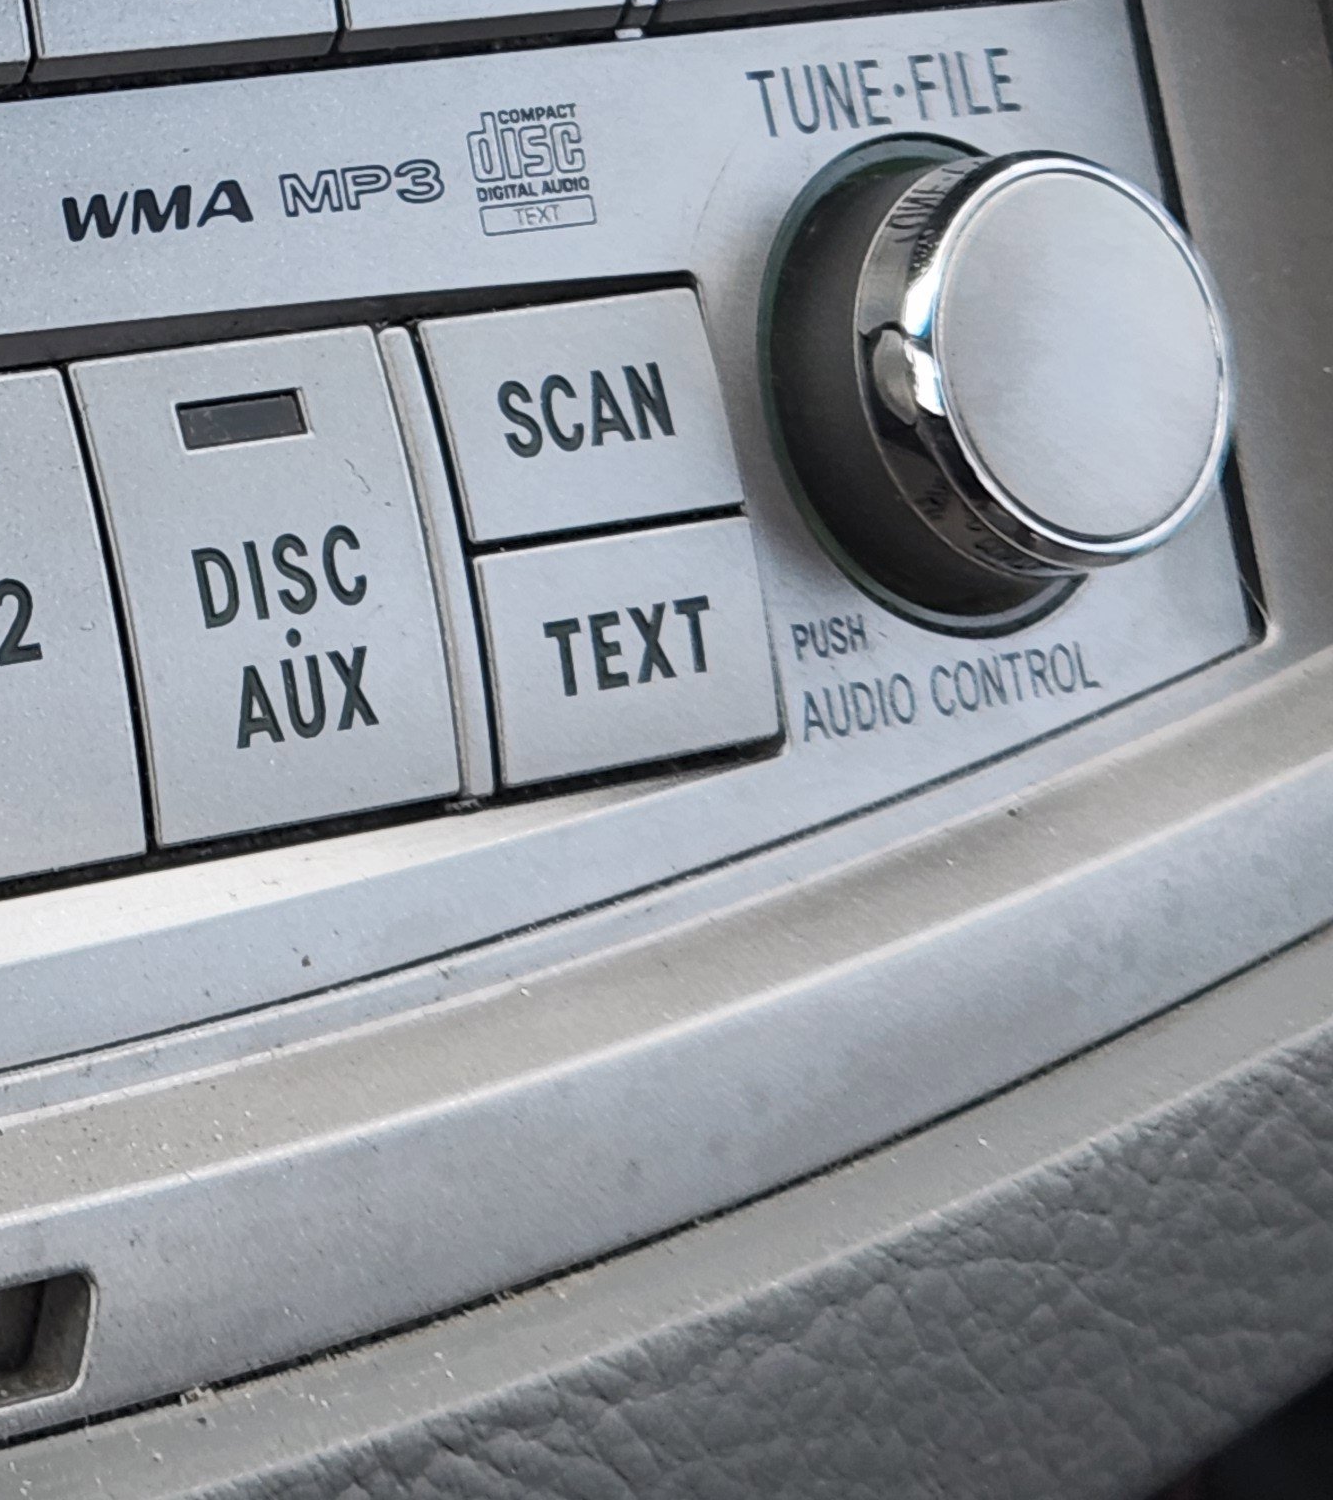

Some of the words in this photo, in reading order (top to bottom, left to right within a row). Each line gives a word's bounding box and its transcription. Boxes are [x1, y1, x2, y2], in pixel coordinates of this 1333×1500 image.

[497, 103, 577, 125] COMPACT
[62, 180, 254, 243] WMA
[279, 159, 445, 218] MP3
[476, 183, 540, 202] DIGITAL
[541, 177, 590, 197] AUDIO
[514, 205, 561, 226] TEXT
[497, 361, 676, 459] SCAN
[190, 525, 368, 629] DISC
[543, 595, 710, 697] TEXT
[790, 613, 868, 661] PUSH
[236, 646, 379, 749] AUX
[803, 672, 916, 742] AUDIO
[930, 641, 1102, 716] CONTROL
